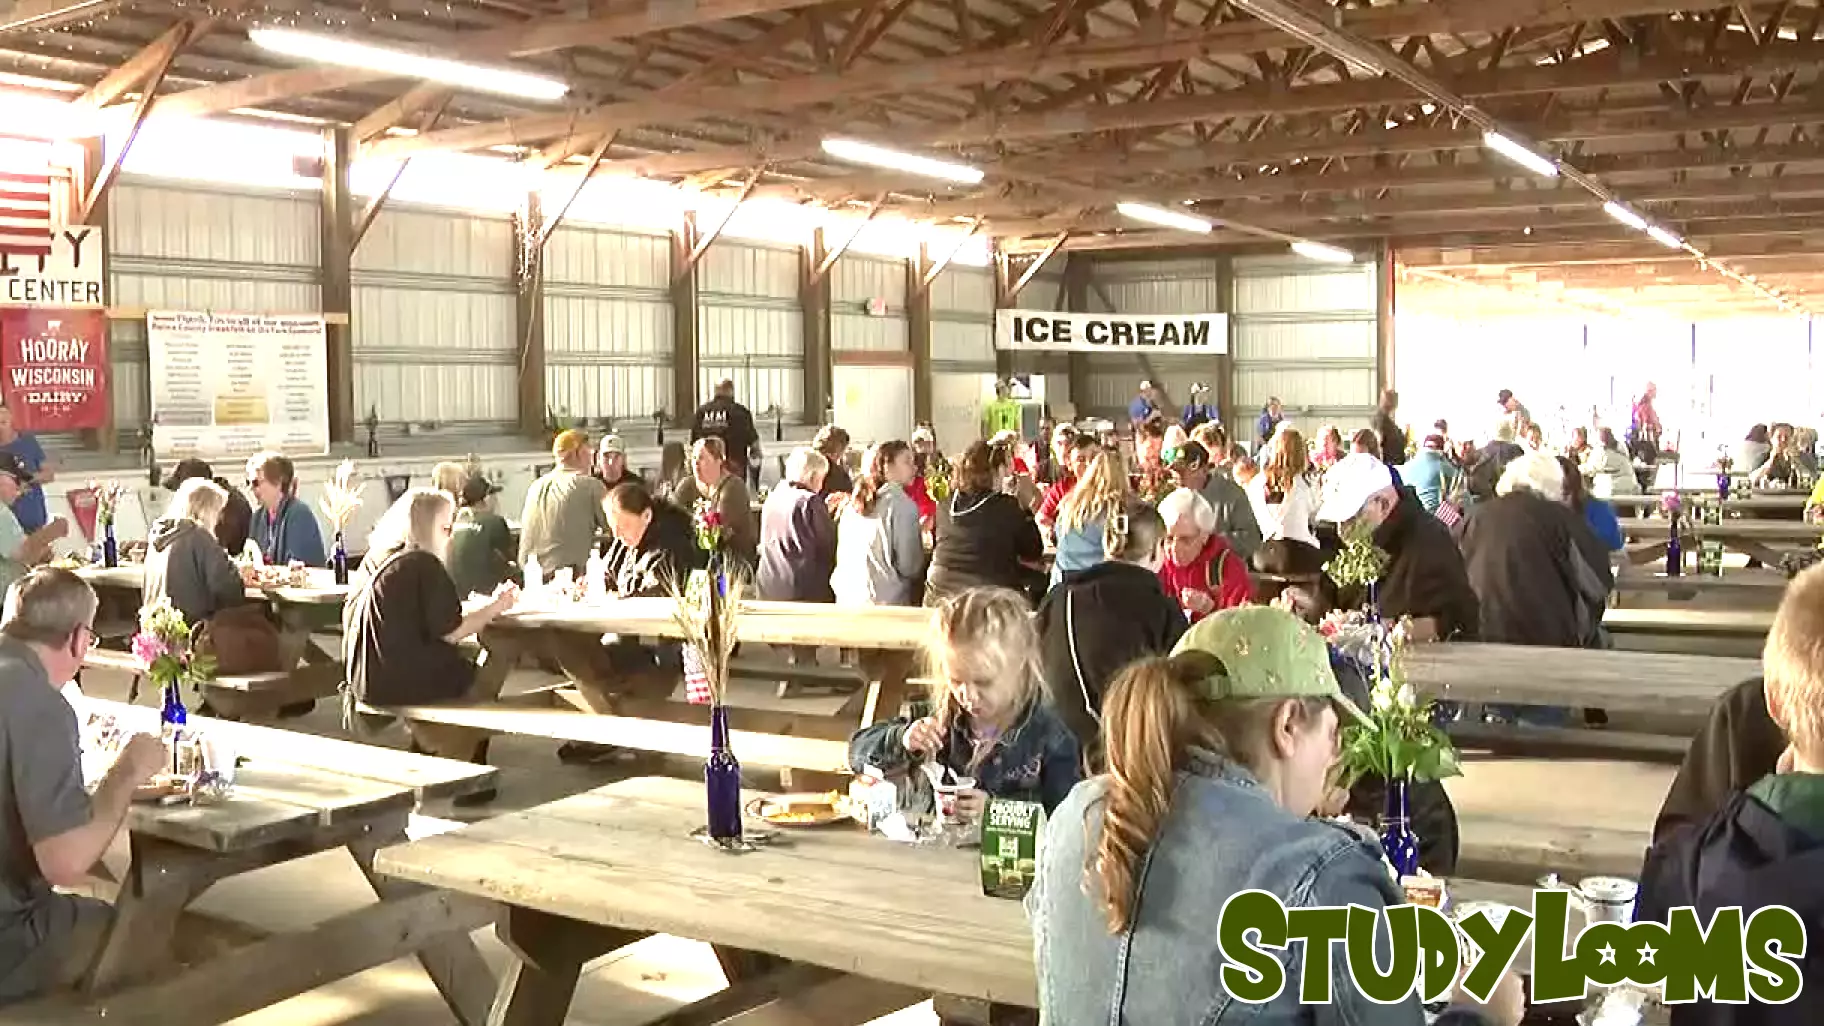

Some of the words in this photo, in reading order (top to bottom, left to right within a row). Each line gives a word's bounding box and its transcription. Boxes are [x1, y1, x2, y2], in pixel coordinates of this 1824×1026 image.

[9, 278, 100, 303] CENTER
[1013, 316, 1072, 343] ICE
[1085, 320, 1210, 346] CREAM
[20, 338, 89, 363] HOORAY
[11, 367, 94, 388] WISCONSIN
[28, 392, 82, 403] DAIRY
[989, 800, 1035, 817] PROUDLY
[989, 813, 1032, 829] SERVING
